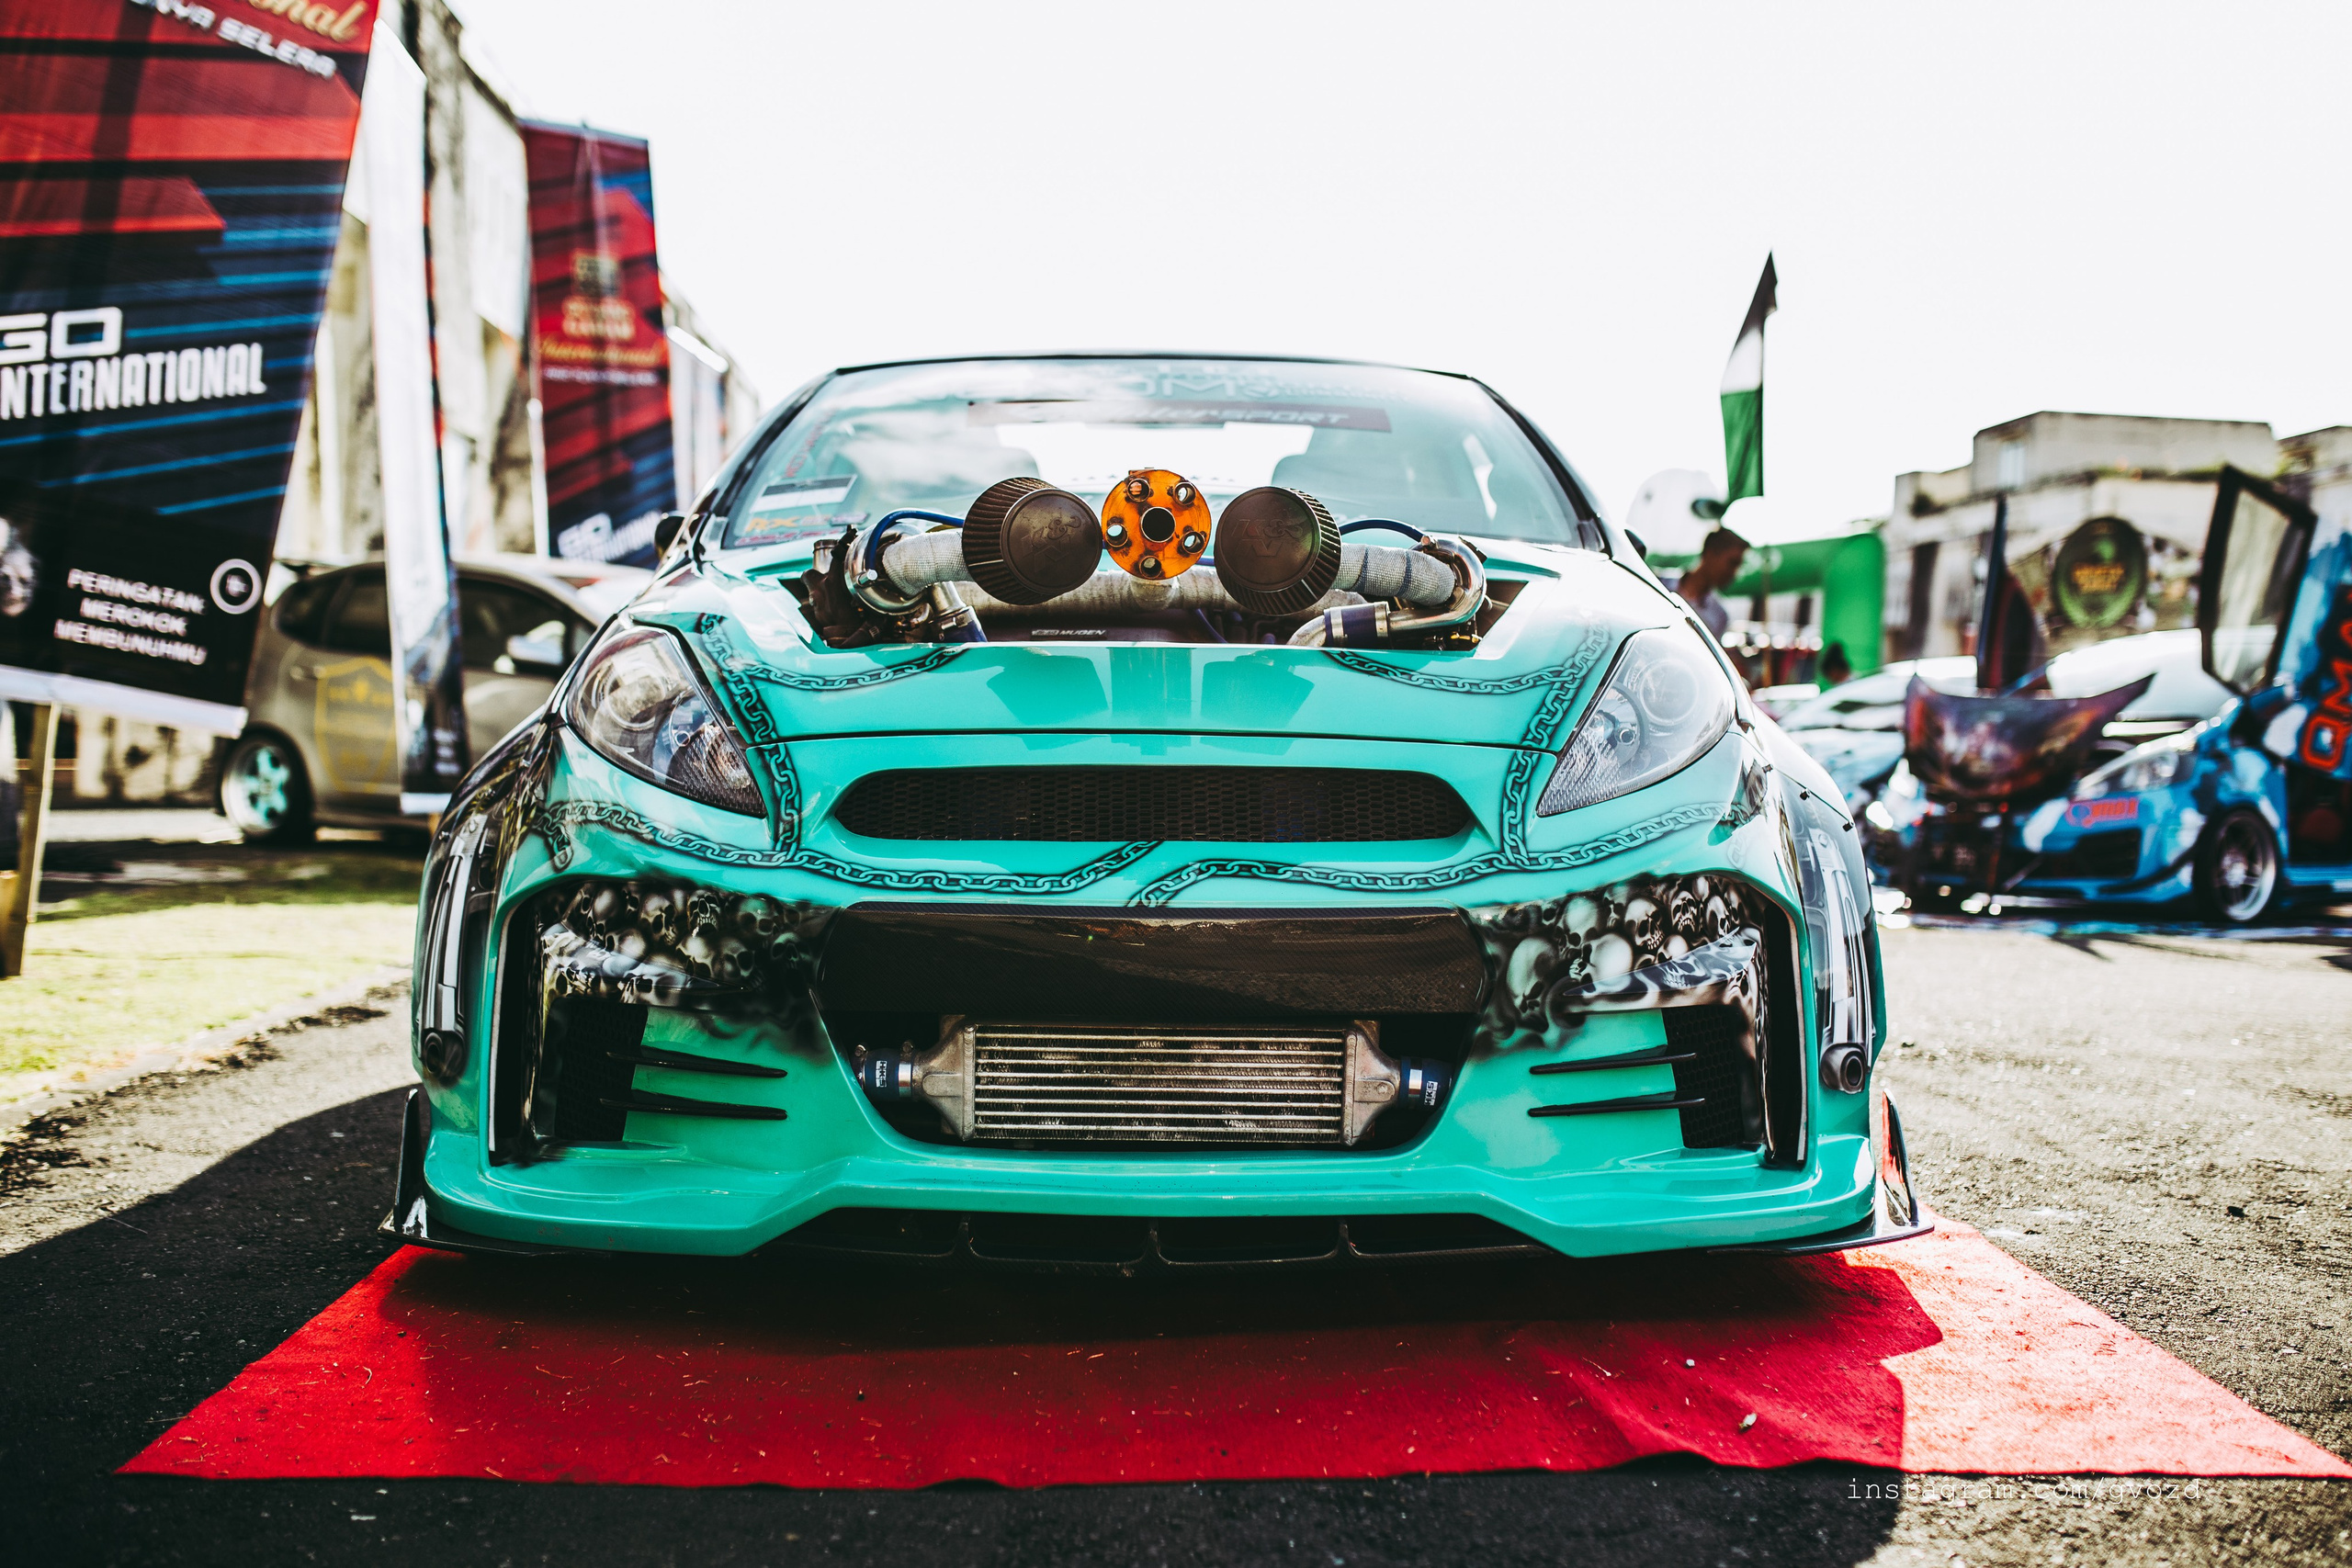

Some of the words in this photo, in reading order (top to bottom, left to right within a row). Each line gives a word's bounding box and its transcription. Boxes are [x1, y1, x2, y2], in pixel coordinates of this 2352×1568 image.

[218, 17, 336, 78] SELERA
[80, 598, 187, 637] MEROKOK
[876, 1060, 888, 1088] HKS
[1425, 1081, 1436, 1105] HKS
